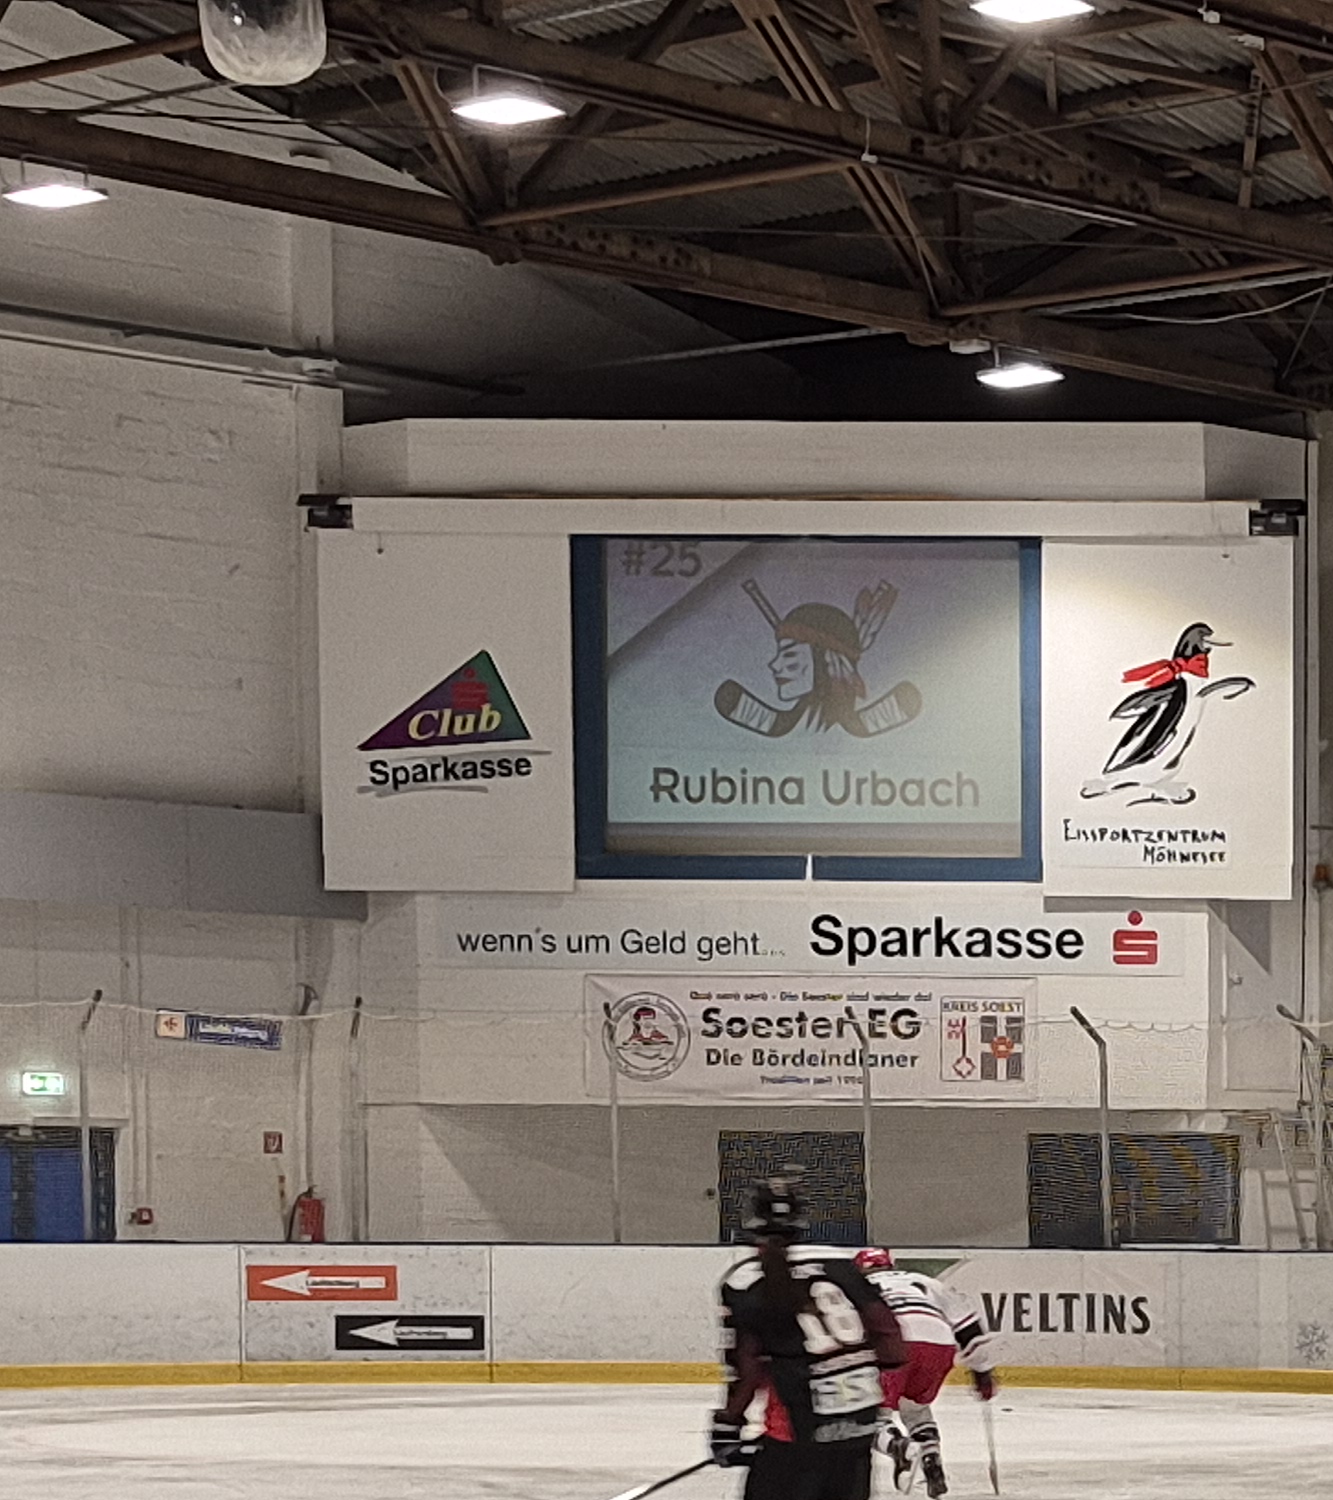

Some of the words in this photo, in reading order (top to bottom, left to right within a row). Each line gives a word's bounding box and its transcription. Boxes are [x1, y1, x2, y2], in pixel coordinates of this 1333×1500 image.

[622, 542, 701, 577] #25
[408, 703, 501, 740] Club
[369, 756, 532, 791] Sparkasse
[650, 766, 805, 806] Rubina
[822, 770, 979, 808] Urbach
[566, 932, 610, 953] um
[620, 928, 686, 954] Geld
[810, 914, 1084, 966] Sparkasse
[701, 1007, 852, 1038] Soester
[868, 1008, 922, 1040] EG
[706, 1048, 743, 1066] Die
[980, 1292, 1150, 1334] VELTINS
